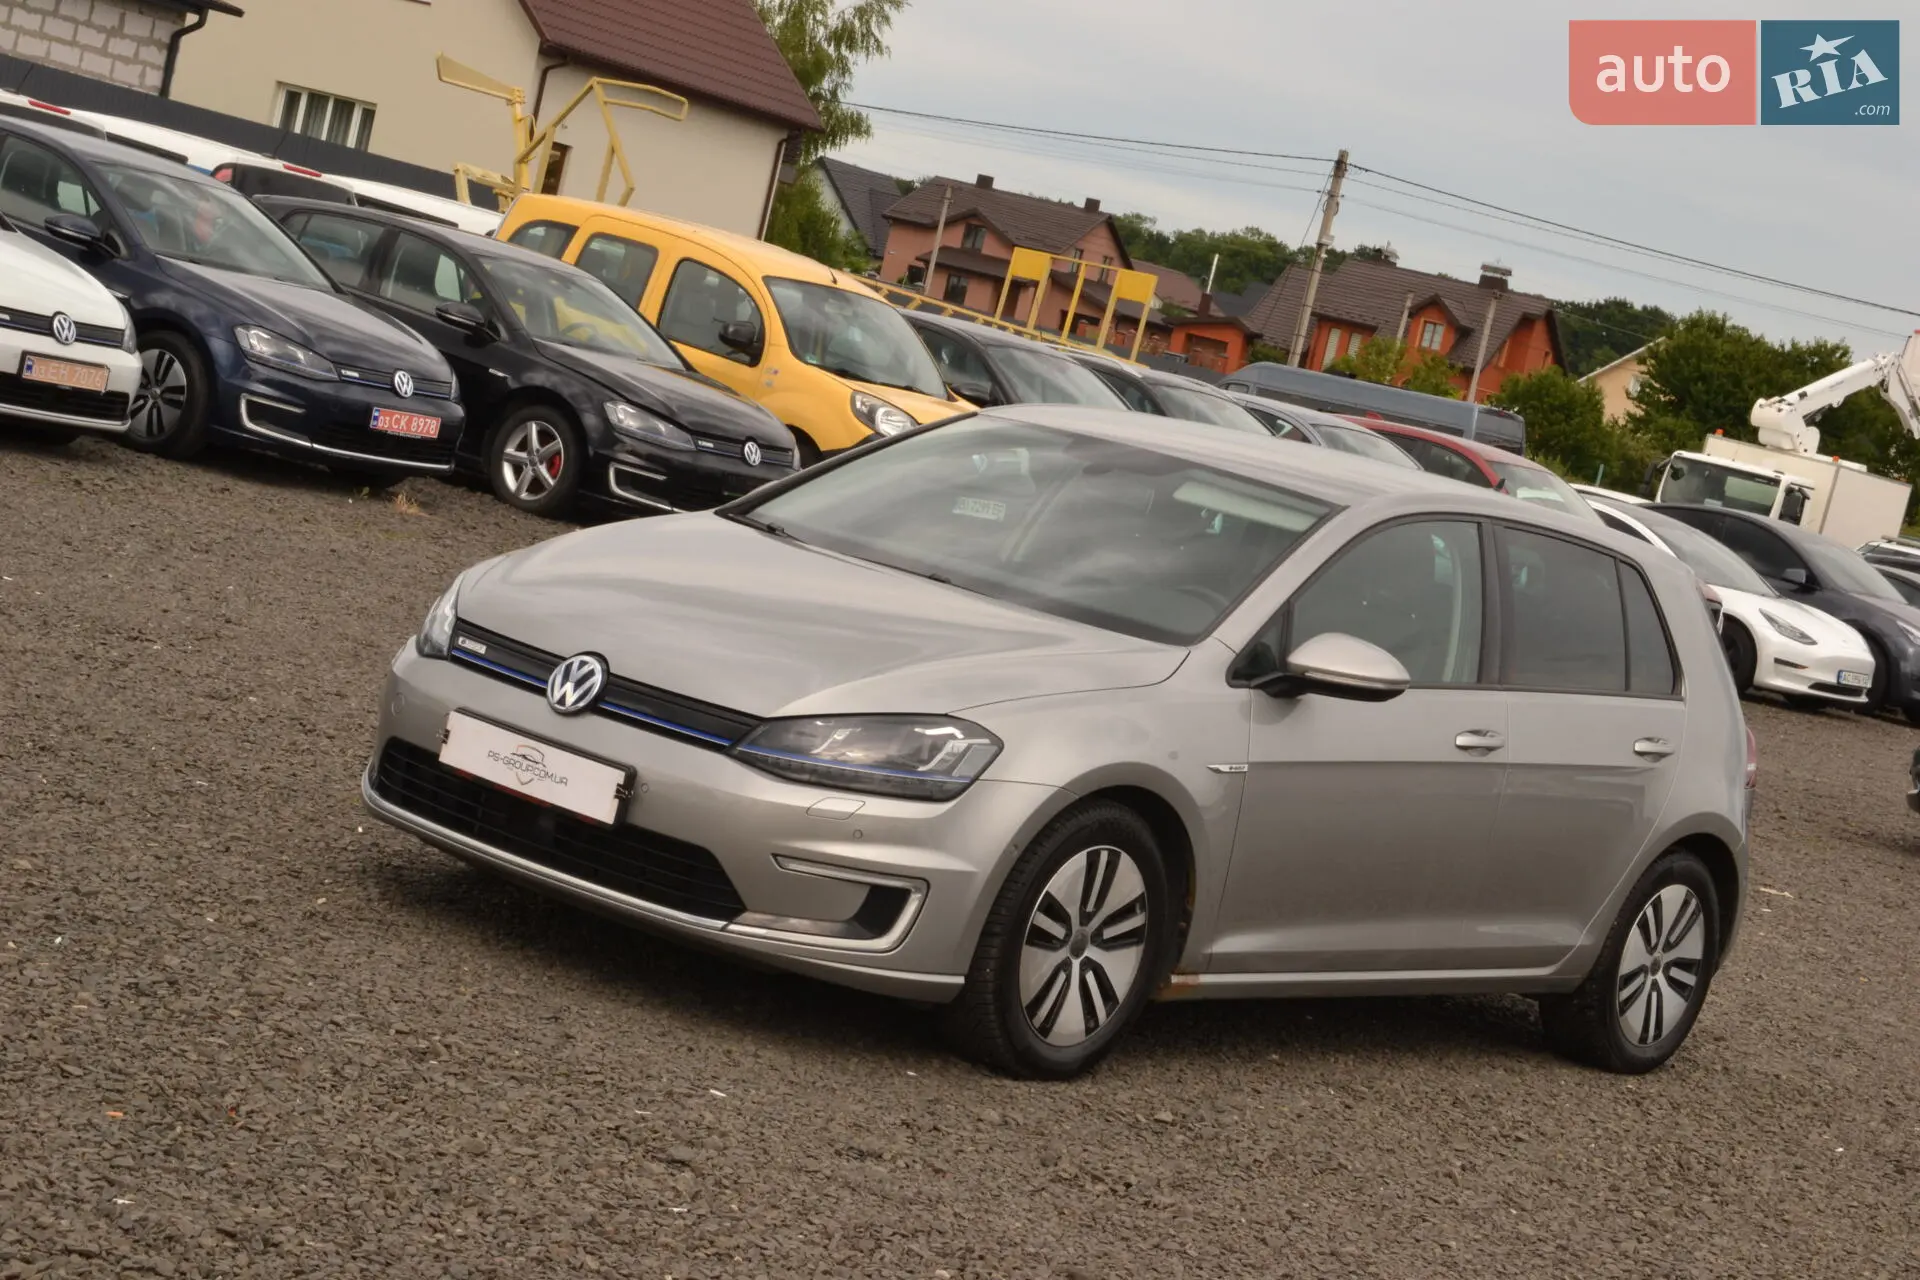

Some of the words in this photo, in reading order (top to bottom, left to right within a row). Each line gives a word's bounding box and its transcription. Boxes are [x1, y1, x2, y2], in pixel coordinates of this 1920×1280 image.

[377, 415, 390, 428] 03
[391, 414, 410, 430] CK
[410, 416, 437, 434] 8978
